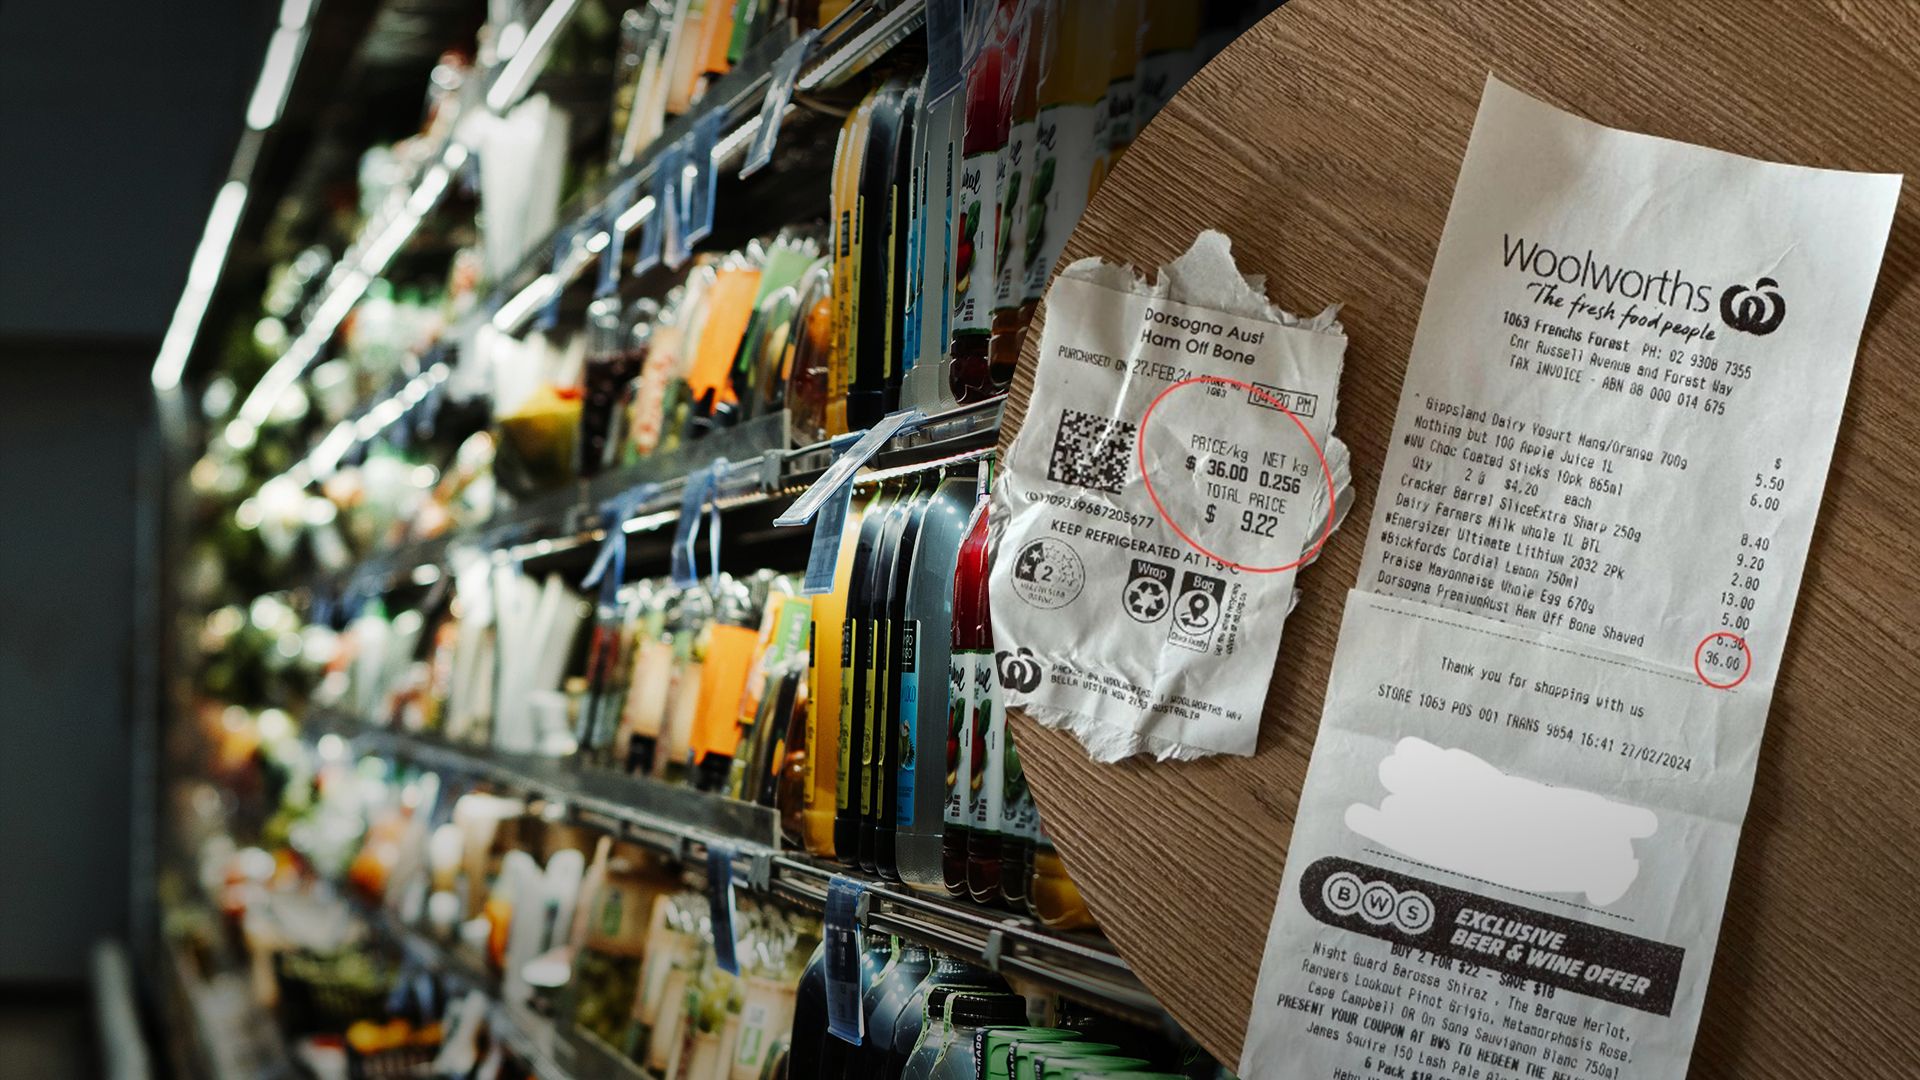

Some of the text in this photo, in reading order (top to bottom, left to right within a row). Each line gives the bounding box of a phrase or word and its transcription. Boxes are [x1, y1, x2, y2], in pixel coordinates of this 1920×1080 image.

[1503, 234, 1712, 313] Woolworths
[1145, 308, 1264, 345] Dorsogna Aust
[1527, 282, 1716, 342] The fresh food people
[1058, 344, 1112, 368] PURCHASED
[1141, 330, 1255, 365] Ham Off Bone
[1504, 310, 1752, 380] 1063 Frenchs PH: 02 9308 7355
[1510, 334, 1733, 397] Cnr Russell Avenue and Forest Way
[1296, 396, 1311, 413] PM
[1510, 354, 1726, 416] TAX INVOICE ABN 000 014 675
[1191, 434, 1309, 476] PRICE/kg NET kg
[1414, 416, 1614, 474] Nothing but 100 Apple Juice 1L
[1426, 396, 1688, 470] Gippsland Dairy Yogurt 700g
[1185, 455, 1301, 494] $ 36.00 0.256
[1412, 456, 1592, 510] Qty 2 $4.20 each
[1430, 438, 1584, 488] Choc Coated Sticks 10pk
[1755, 473, 1784, 491] 5.50
[1774, 458, 1782, 469] $
[1205, 503, 1278, 538] $ 9.22
[1207, 482, 1287, 514] TOTAL PRICE
[1400, 472, 1642, 544] Cracker Barrel SliceExtra Sharp 250g
[1750, 493, 1780, 511] 6.00
[1050, 518, 1202, 566] KEEP REFRIGERATED AT
[1396, 492, 1600, 554] Dairy Farmers Milk 1L BTL
[1741, 532, 1770, 551] 8.40
[1137, 562, 1168, 580] Wrap
[1452, 546, 1500, 570] Cordial
[1504, 560, 1540, 580] Lemon
[1458, 526, 1598, 574] Ultimate 2032
[1736, 553, 1765, 572] 9.20
[1041, 565, 1053, 582] 2
[1193, 575, 1215, 593] Bag
[1382, 550, 1424, 572] Praise
[1428, 562, 1494, 590] Mayonnaise
[1540, 588, 1562, 608] Egg
[1566, 596, 1594, 614] 670g
[1378, 570, 1432, 594] Dorsogna
[1514, 604, 1538, 620] Ham
[1542, 610, 1564, 626] Off
[1568, 616, 1596, 636] Bone
[1602, 624, 1644, 648] Shaved
[1720, 592, 1755, 611] 13.00
[1722, 613, 1750, 630] 5.00
[1704, 650, 1740, 671] 36.00
[1051, 674, 1201, 720] BELLA AUSTRALIA
[1442, 656, 1644, 718] Thank you for shopping us
[1378, 684, 1692, 772] STORE 1063 POS 001 TRANS 16:41 27/02/2024
[1455, 907, 1567, 952] EXCLUSIVE
[1417, 951, 1527, 992] 2 FOR $22 SAVE
[1449, 930, 1651, 996] BEER & WINE OFFER
[1302, 958, 1592, 1052] Rangers Lookout Pinot Metamorphosis
[1312, 940, 1630, 1042] Night Guard Barossa Shiraz The Barque Merlot,
[1276, 994, 1324, 1016] PRESENT
[1330, 1006, 1358, 1026] YOUR
[1364, 1016, 1406, 1038] COUPON
[1410, 1028, 1424, 1044] AT
[1458, 1040, 1472, 1058] TO
[1526, 1062, 1546, 1080] THE
[1306, 1022, 1340, 1040] James
[1346, 1030, 1386, 1054] Squire
[1394, 1044, 1414, 1062] 150
[1418, 1050, 1446, 1070] Lash
[1452, 1060, 1480, 1080] Pale
[1342, 988, 1578, 1068] Campbell OR On Song Sauvignon Blanc
[1364, 1056, 1372, 1068] 6
[1377, 1060, 1406, 1079] Pack
